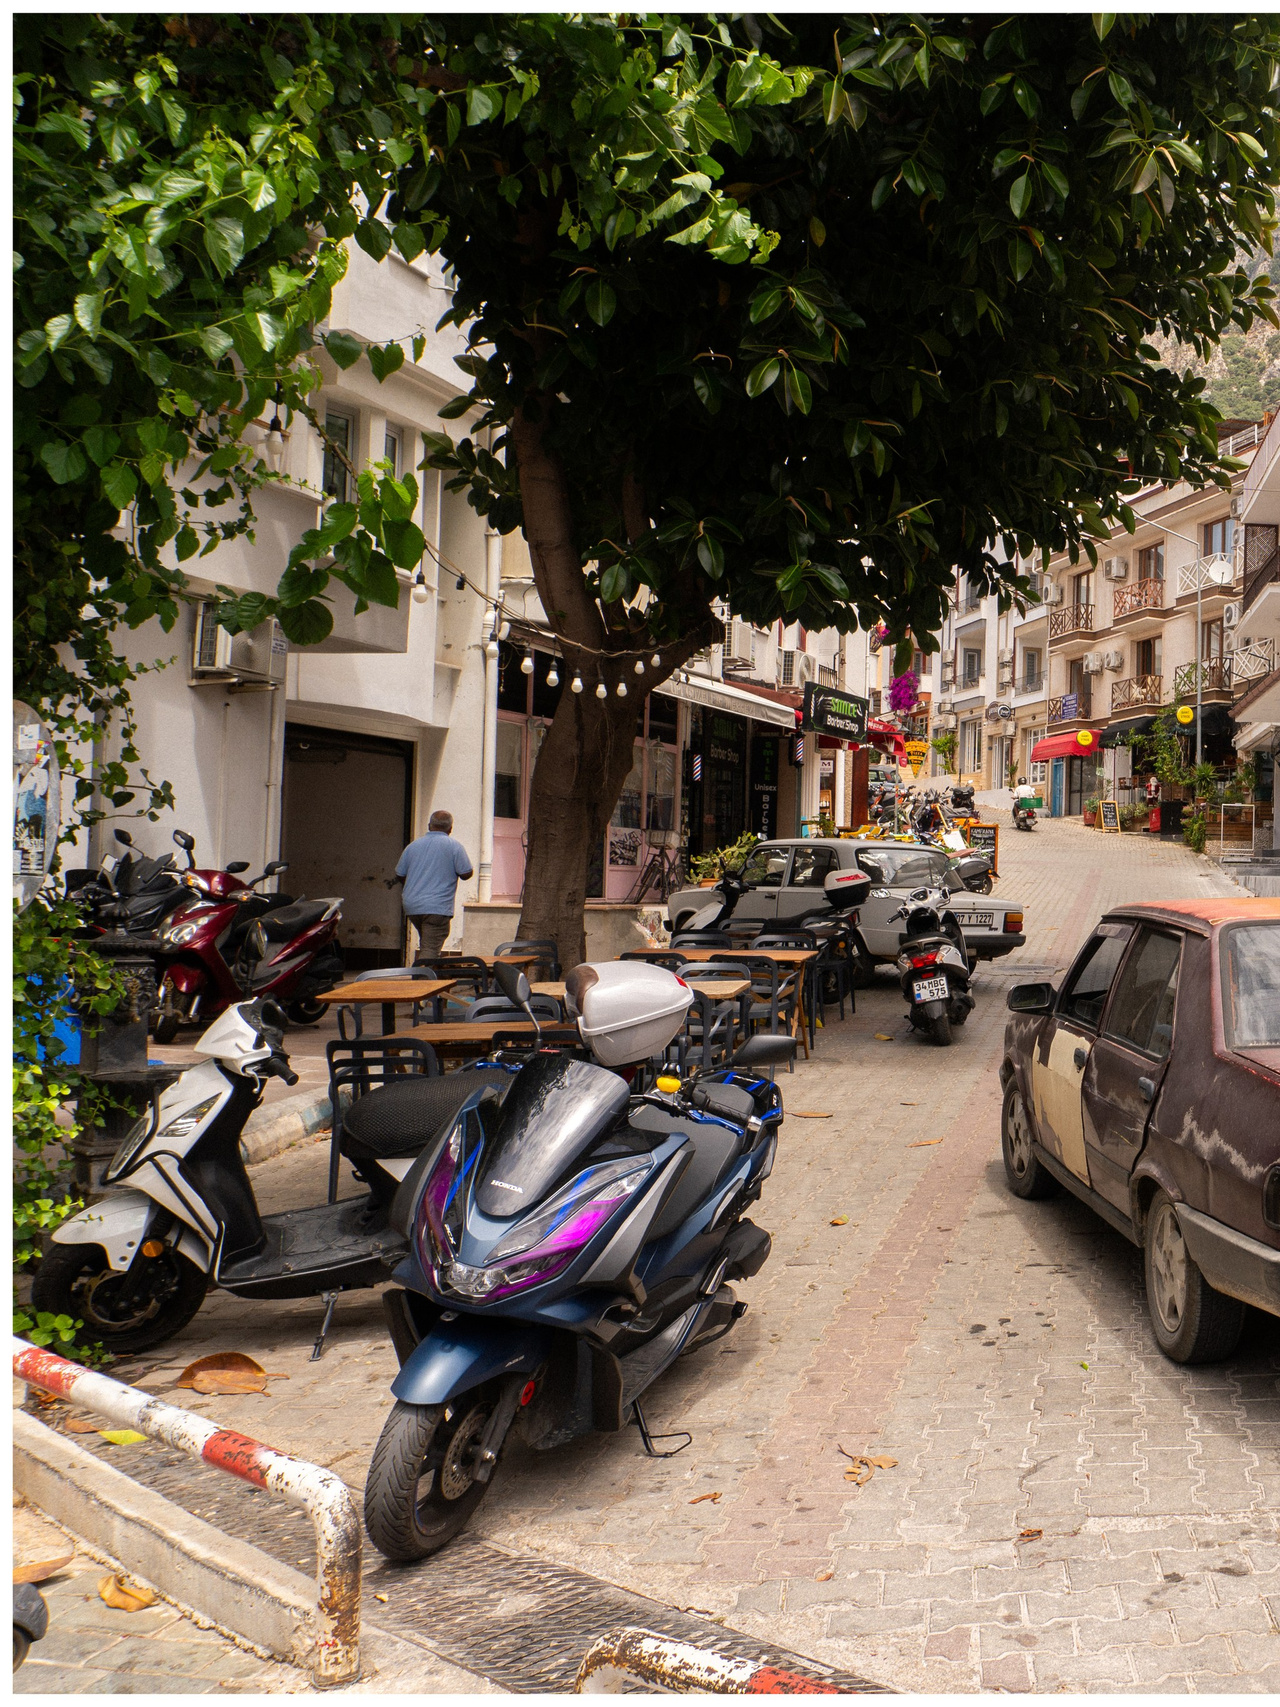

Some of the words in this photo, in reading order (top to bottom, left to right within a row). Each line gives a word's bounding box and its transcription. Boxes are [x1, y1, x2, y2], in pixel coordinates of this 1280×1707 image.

[826, 714, 846, 731] Barber
[845, 720, 859, 734] Shop
[754, 783, 777, 792] Unisex
[762, 794, 770, 839] Barbe
[967, 914, 972, 924] Y
[975, 914, 992, 924] 1227
[915, 983, 927, 992] 34
[927, 978, 945, 990] MBC
[929, 987, 947, 997] 575
[490, 1179, 524, 1194] HONDA
